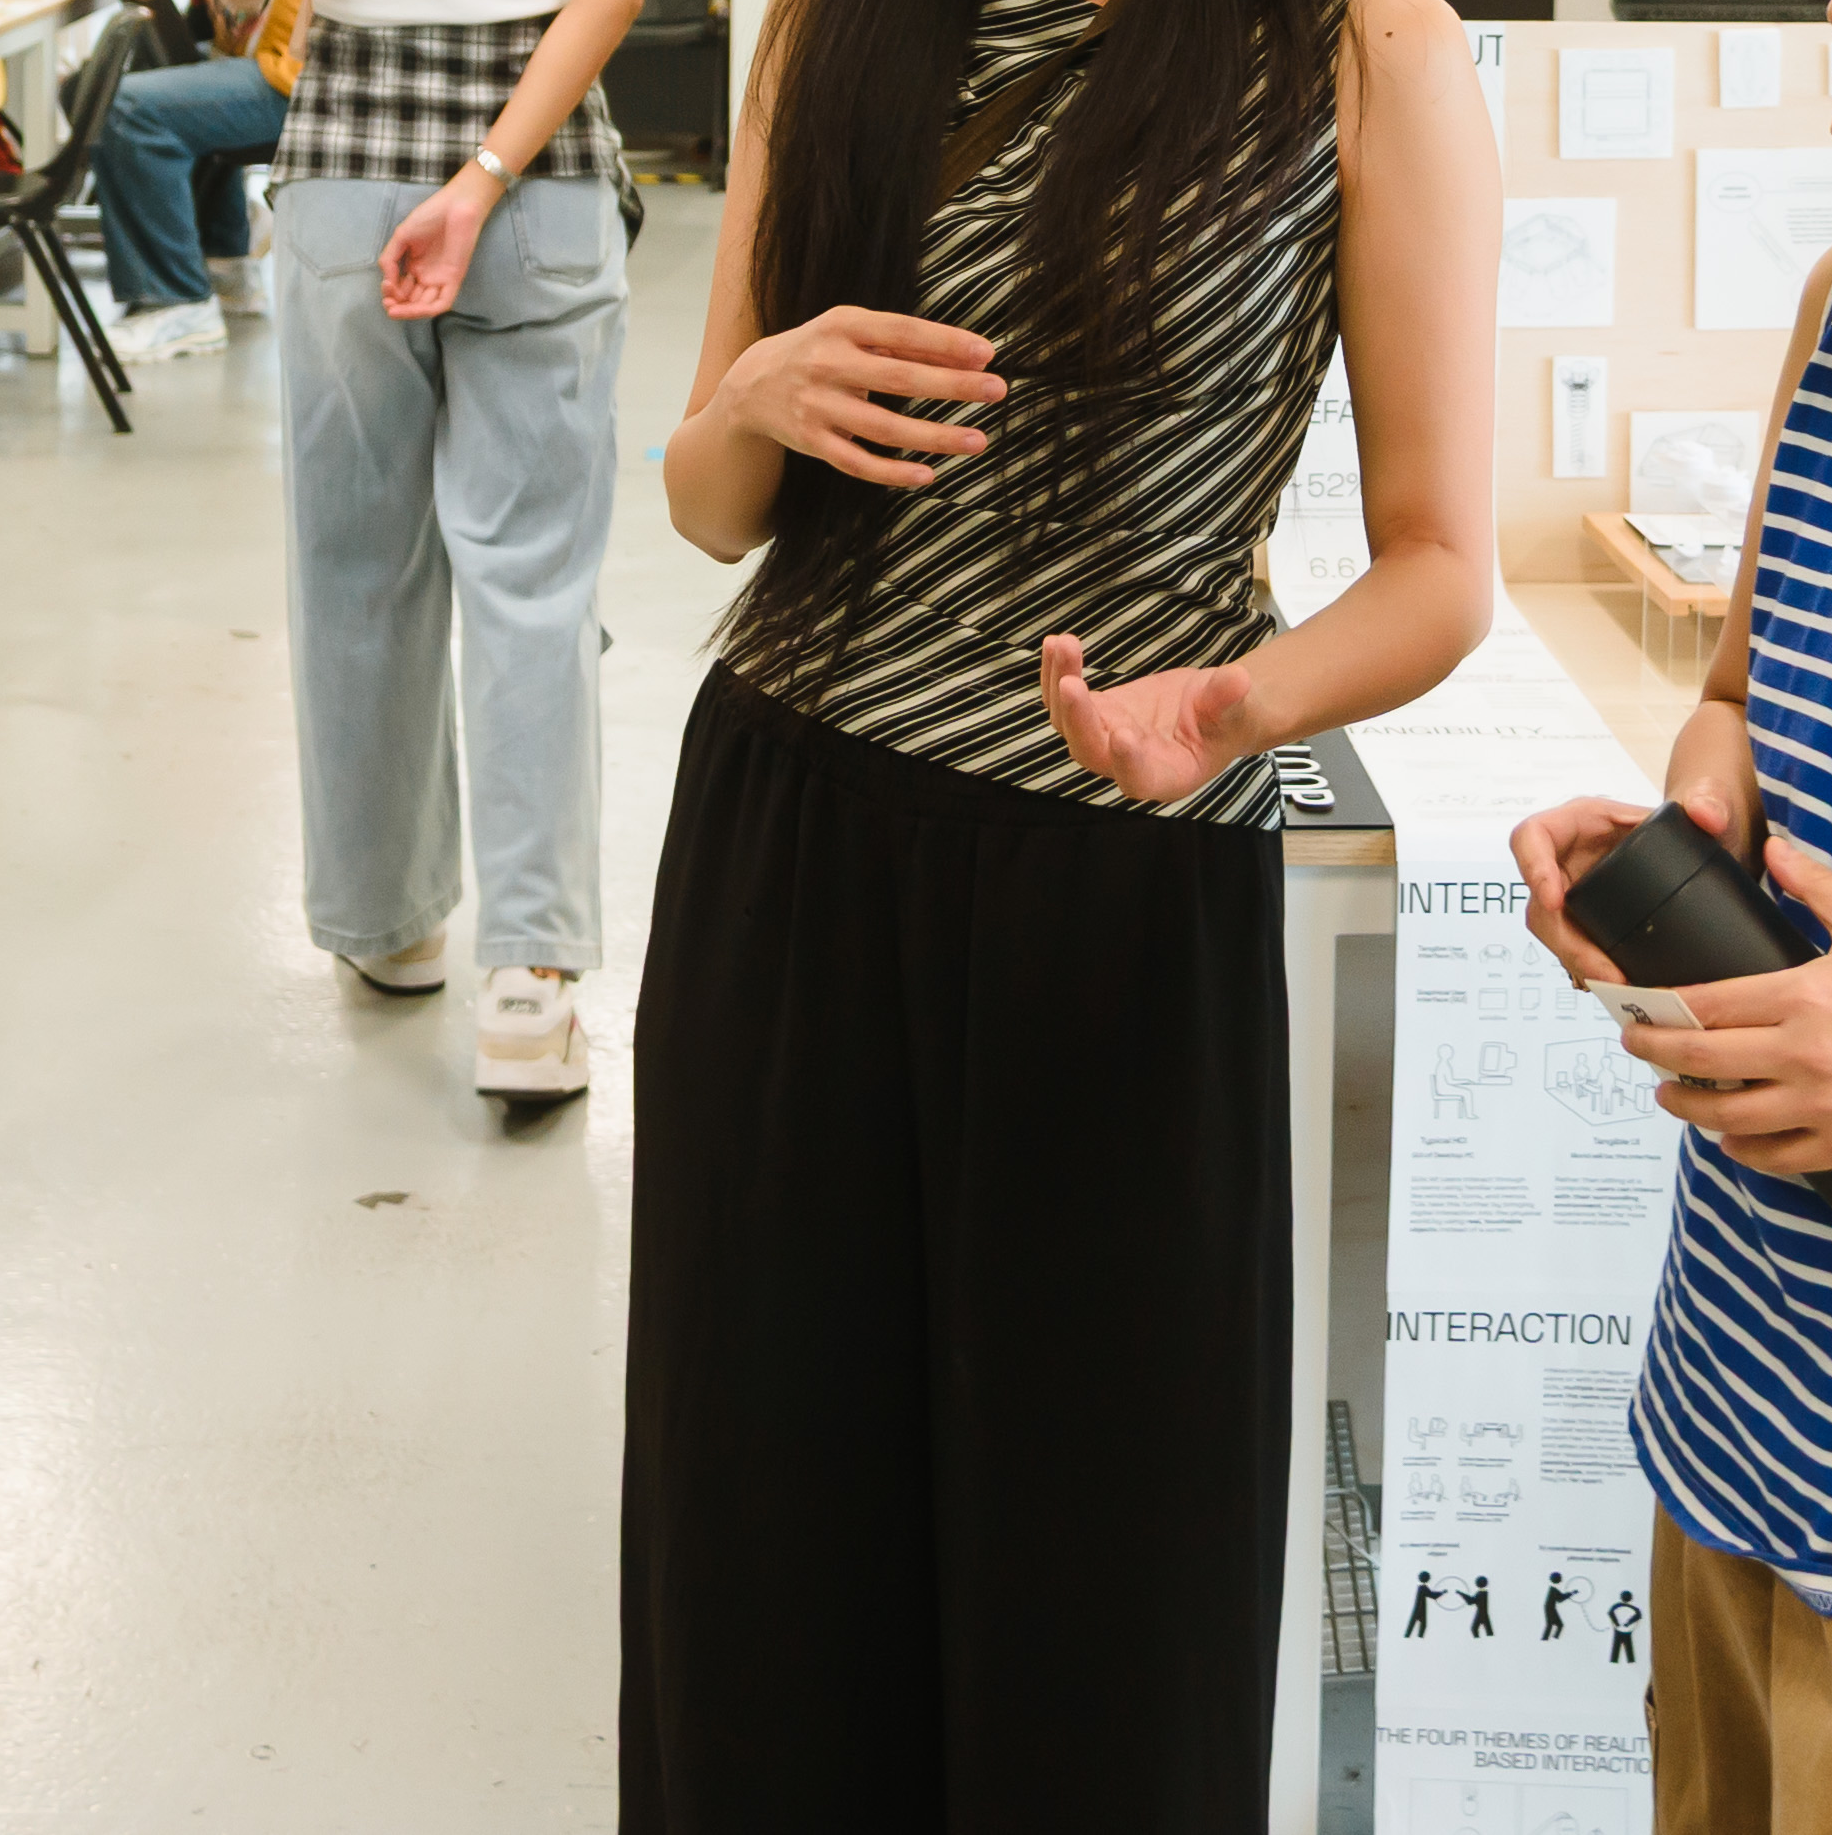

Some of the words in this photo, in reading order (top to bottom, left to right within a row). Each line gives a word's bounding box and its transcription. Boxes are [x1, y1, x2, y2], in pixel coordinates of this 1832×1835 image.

[1309, 557, 1356, 579] 6.6
[1400, 882, 1528, 914] INTERF
[1386, 1311, 1631, 1345] INTERACTION
[1376, 1726, 1411, 1745] THE
[1417, 1728, 1467, 1746] FOUR
[1473, 1730, 1549, 1750] THEMES
[1555, 1733, 1580, 1751] OF
[1584, 1735, 1648, 1753] REALIT
[1474, 1751, 1537, 1770] BASED
[1542, 1754, 1651, 1774] INTERACTIO
